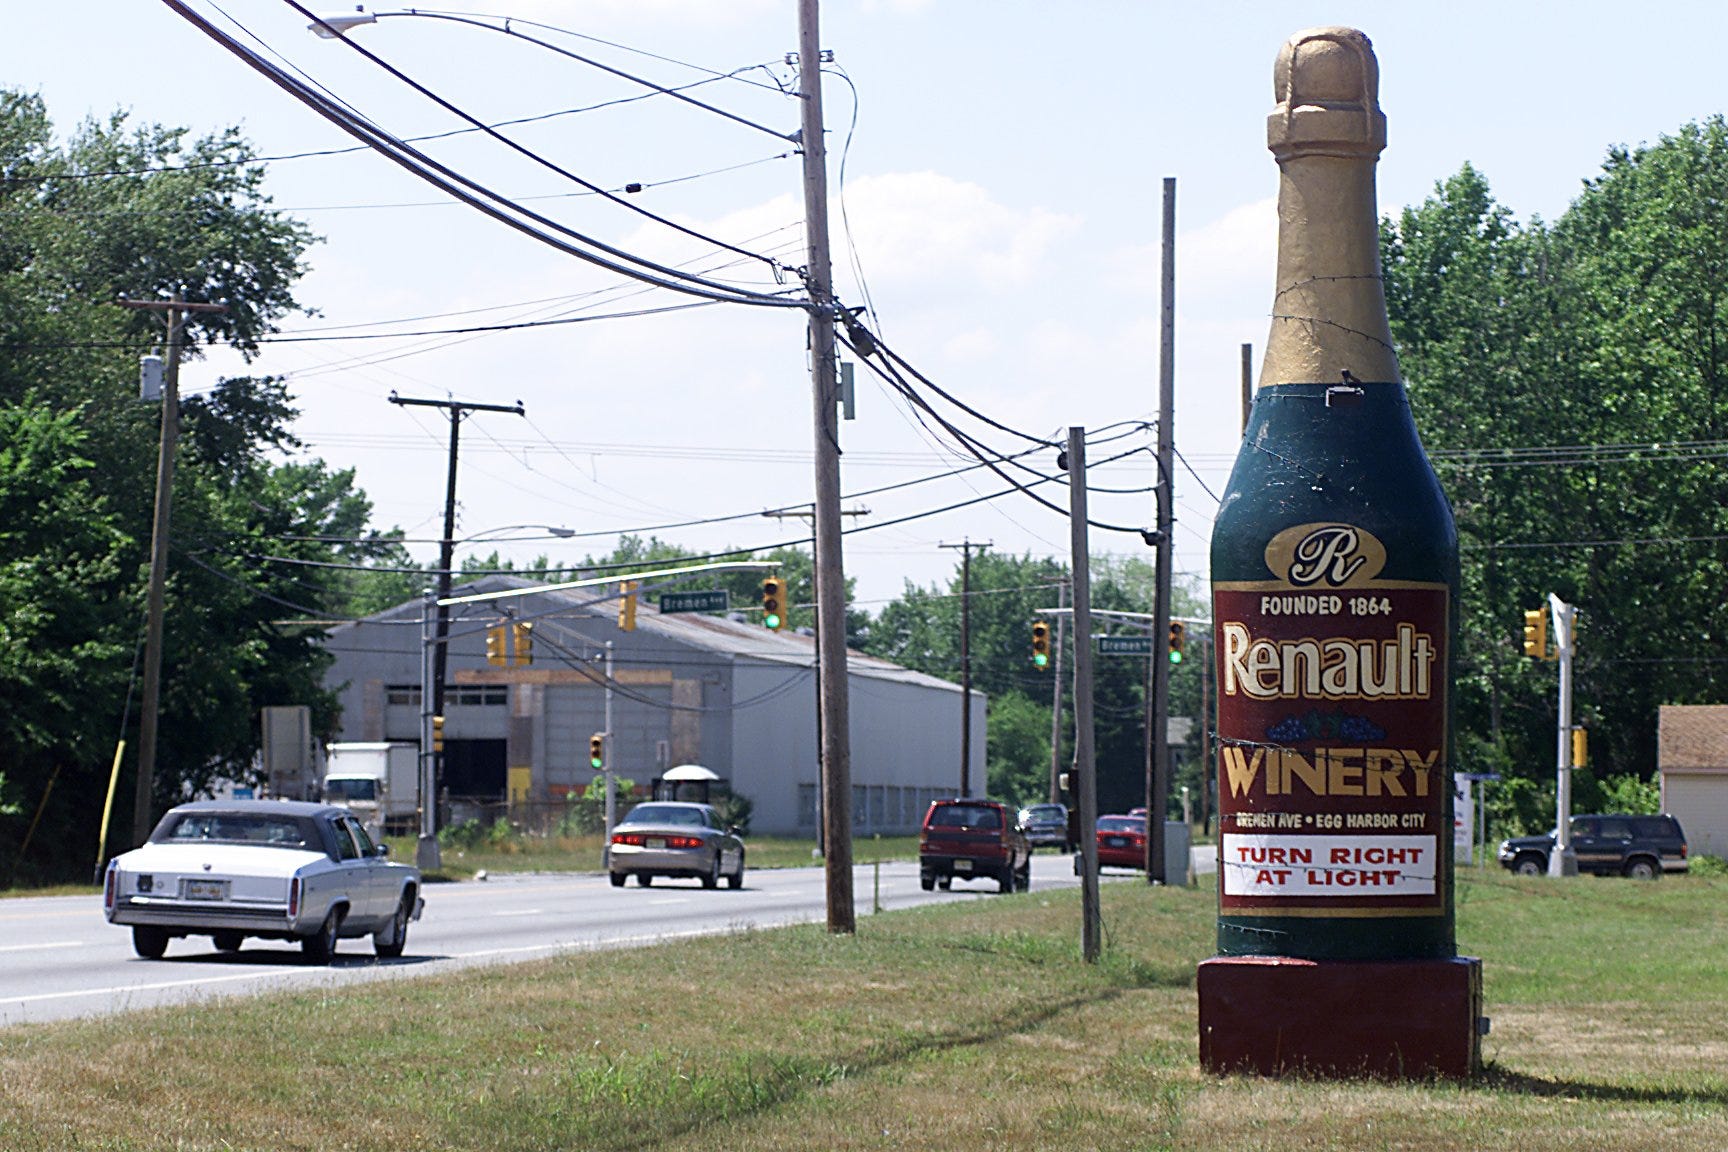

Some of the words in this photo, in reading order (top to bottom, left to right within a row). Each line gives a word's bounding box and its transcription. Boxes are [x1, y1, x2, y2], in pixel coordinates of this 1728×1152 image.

[1261, 595, 1342, 615] FOUNDED
[1349, 597, 1392, 615] 1864
[1222, 622, 1436, 700] Renault
[1223, 747, 1440, 799] WINERY
[1316, 813, 1343, 828] EGG
[1347, 813, 1398, 828] HARBOR
[1402, 813, 1427, 828] CITY
[1237, 847, 1313, 863] TURN
[1330, 848, 1424, 864] RIGHT
[1255, 870, 1292, 885] AT
[1308, 870, 1401, 886] LIGHT
